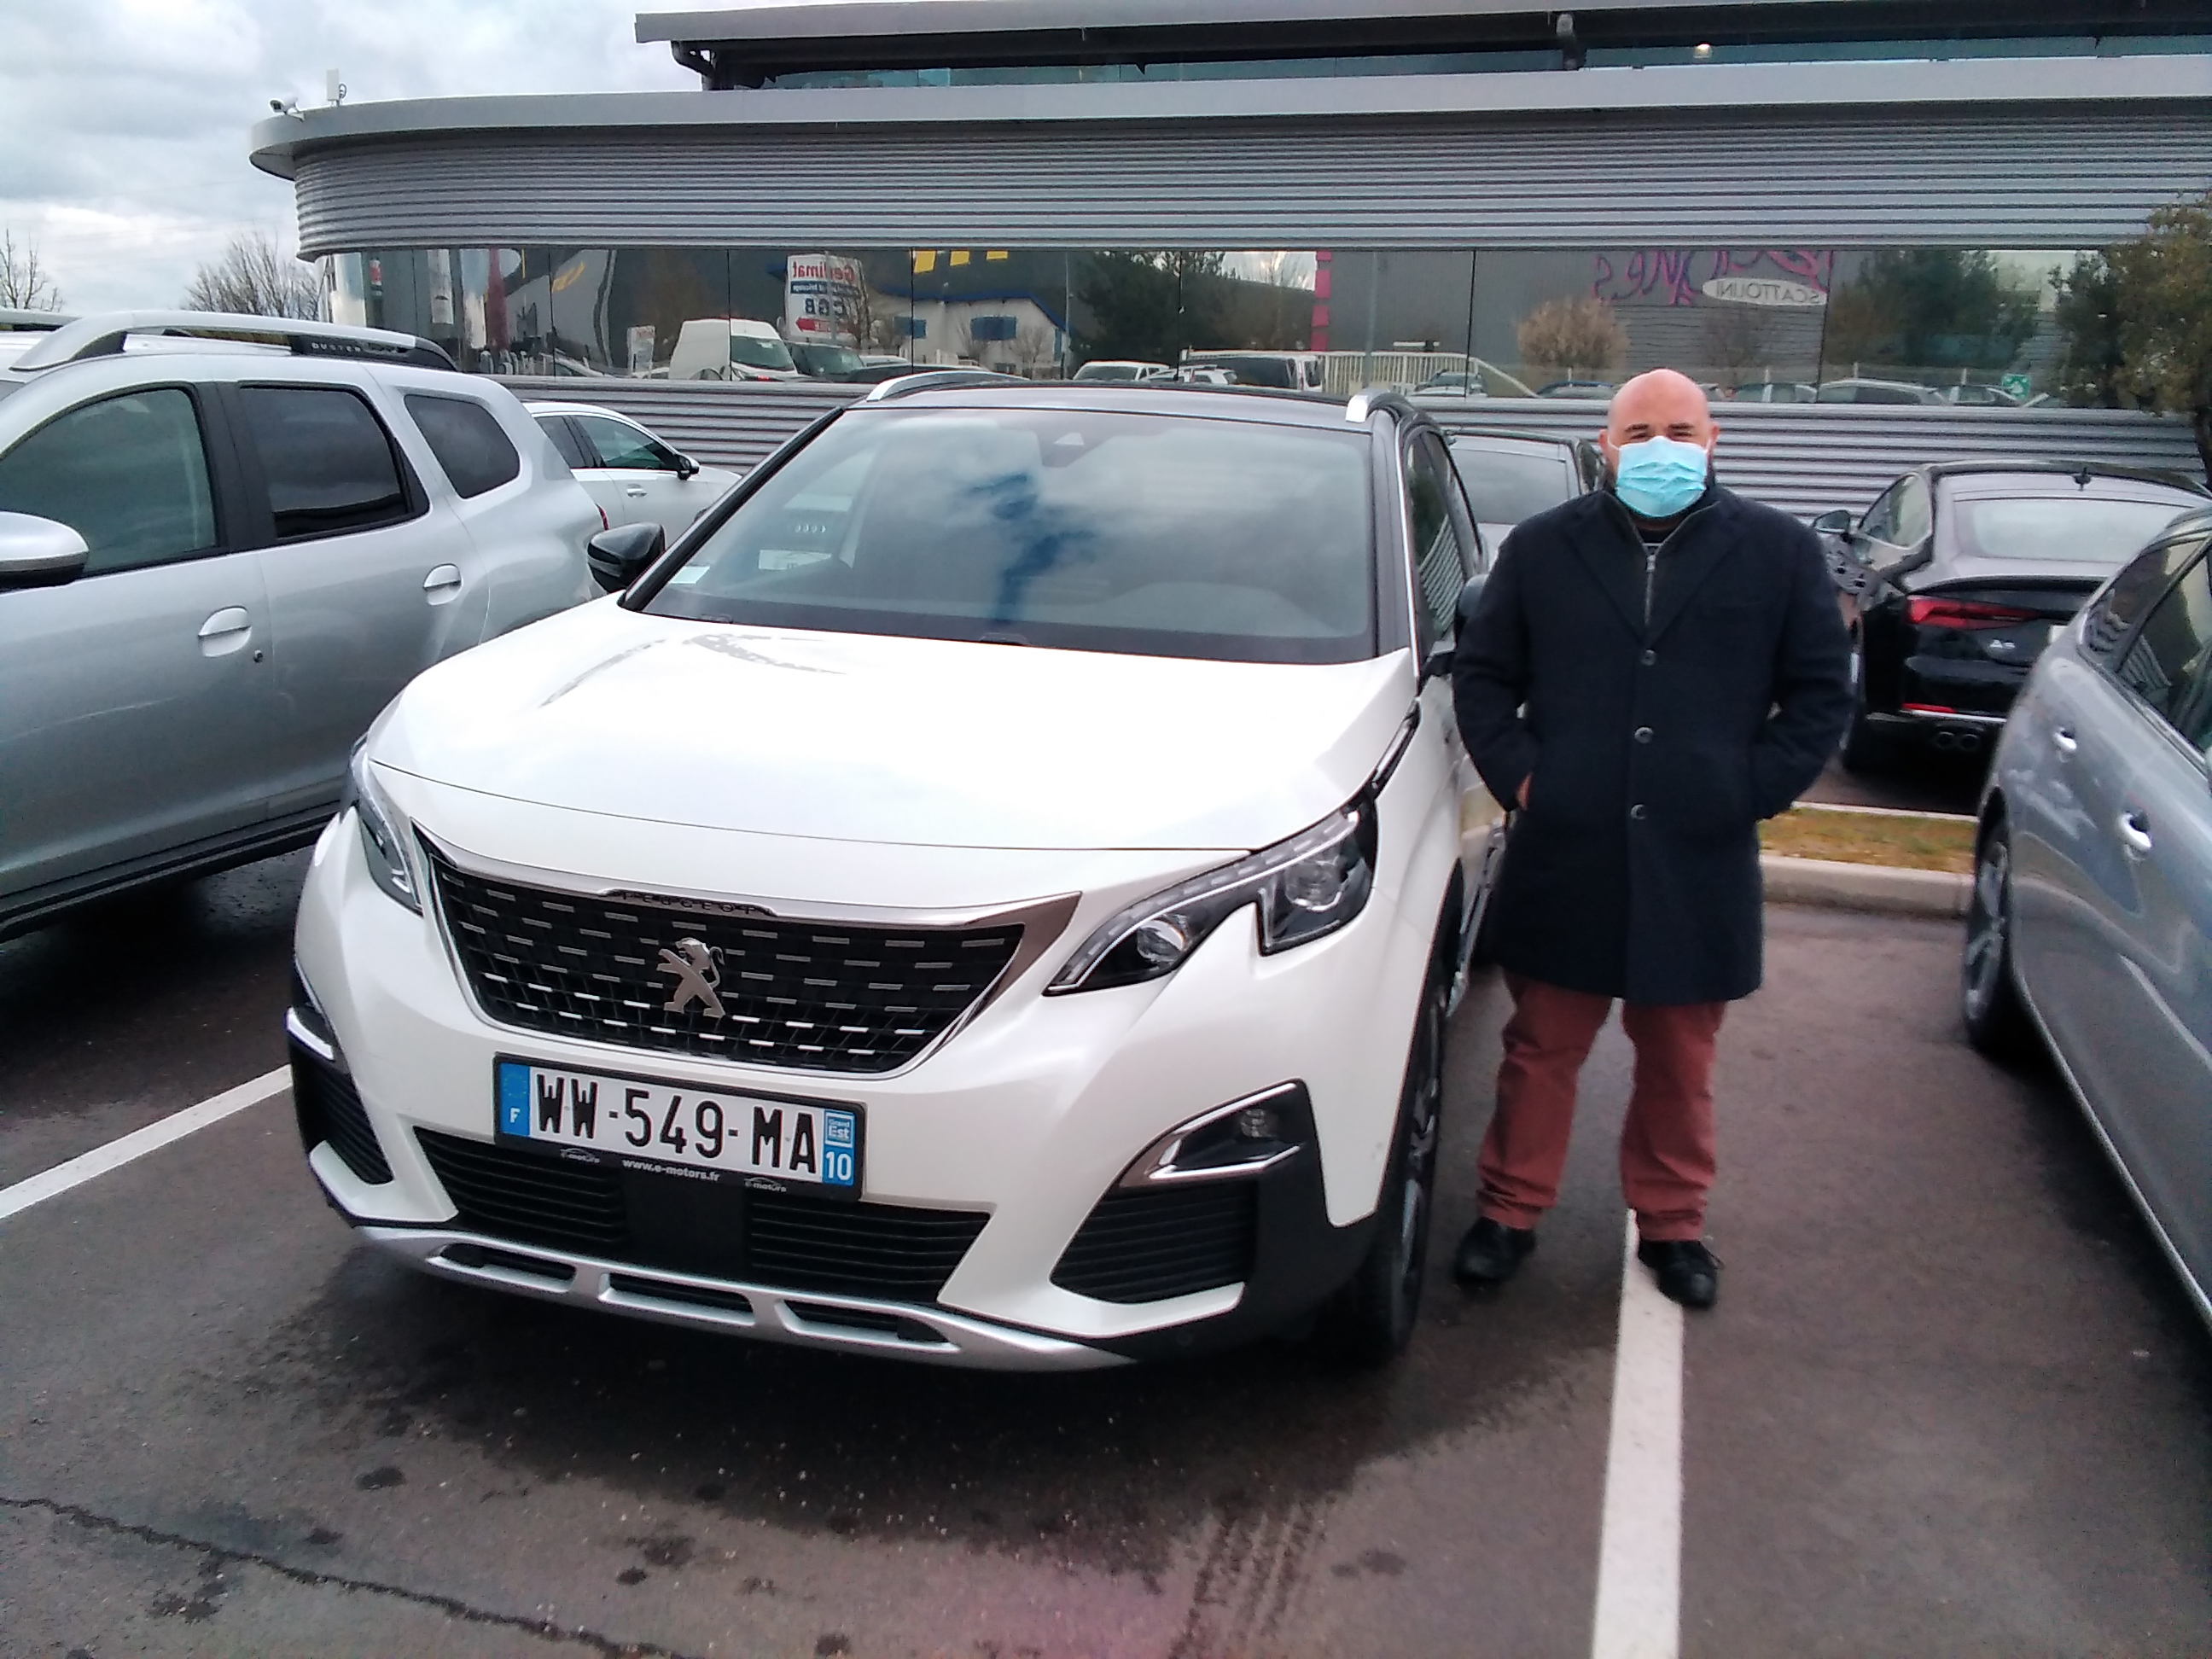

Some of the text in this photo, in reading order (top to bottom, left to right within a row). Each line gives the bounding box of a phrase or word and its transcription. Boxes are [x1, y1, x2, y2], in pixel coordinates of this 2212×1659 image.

[622, 891, 755, 915] PEUGEOT
[509, 1107, 521, 1124] F
[828, 1126, 850, 1139] Est
[621, 1158, 721, 1182] www.e-motors.fr
[825, 1151, 853, 1181] 10
